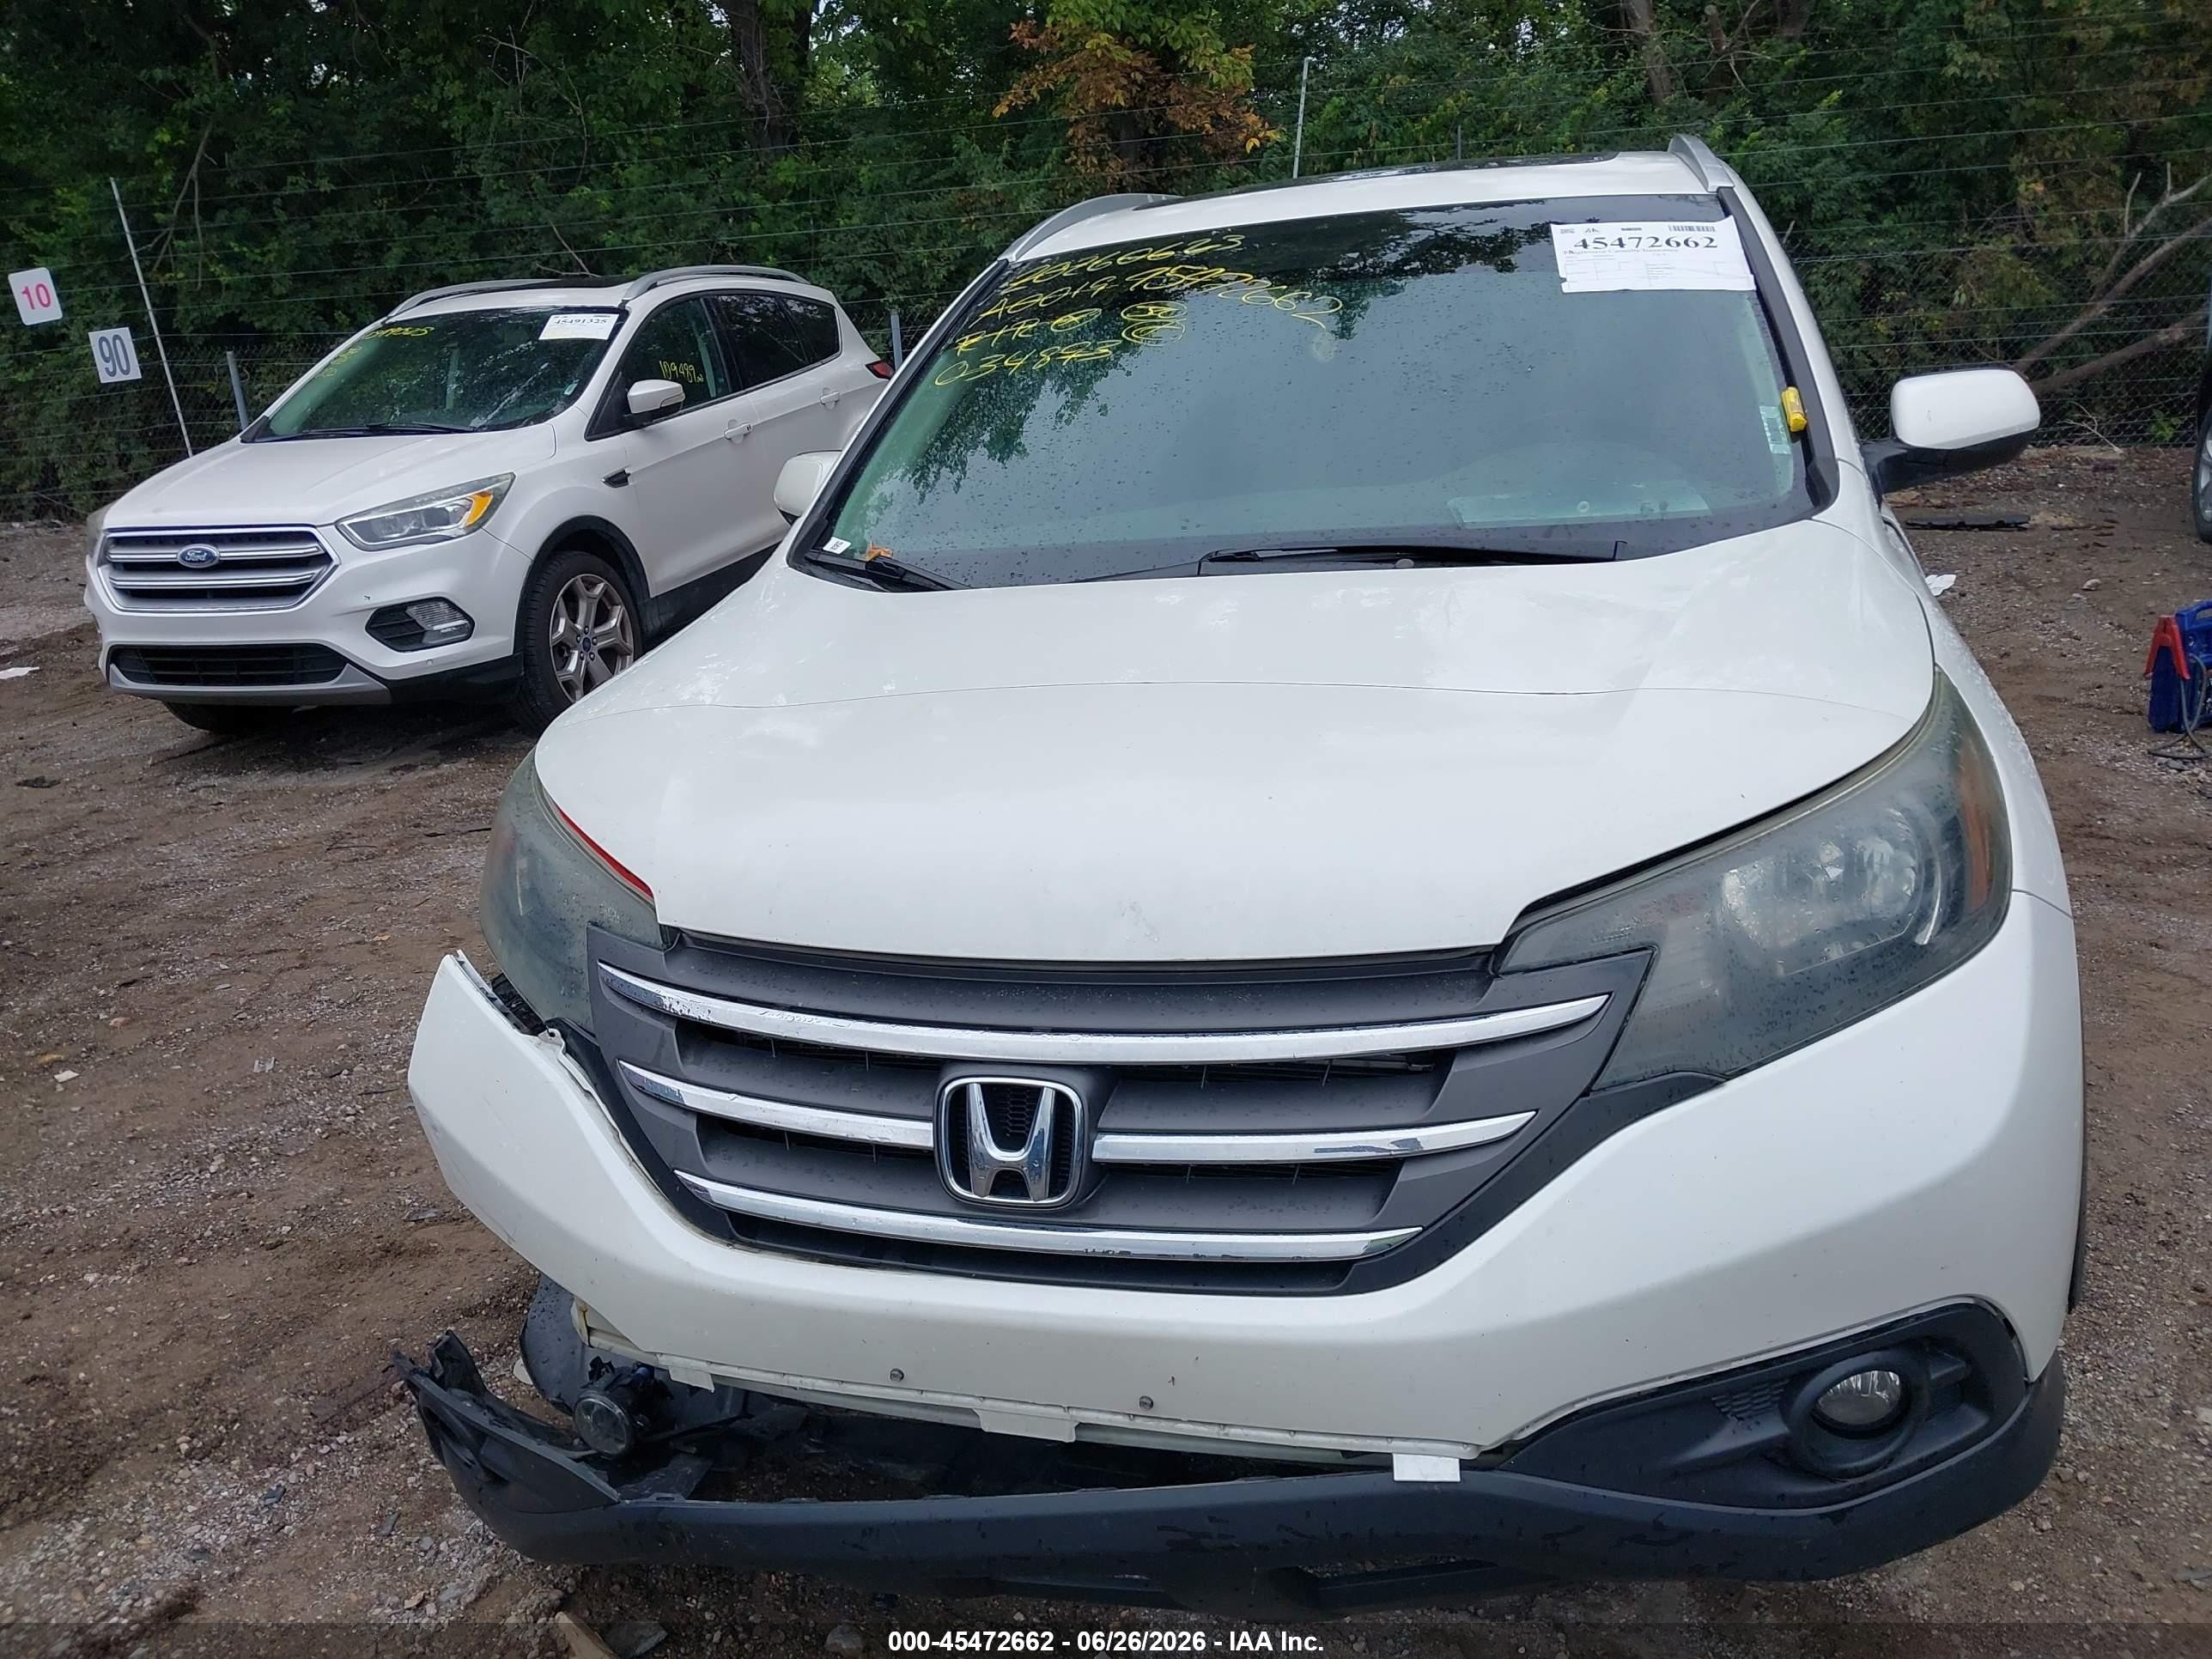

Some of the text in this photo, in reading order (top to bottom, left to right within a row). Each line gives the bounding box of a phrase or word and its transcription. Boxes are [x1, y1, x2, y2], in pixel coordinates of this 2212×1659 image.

[1573, 235, 1719, 250] 45472662
[21, 283, 52, 309] 10
[97, 333, 131, 377] 90
[185, 550, 208, 562] Ford
